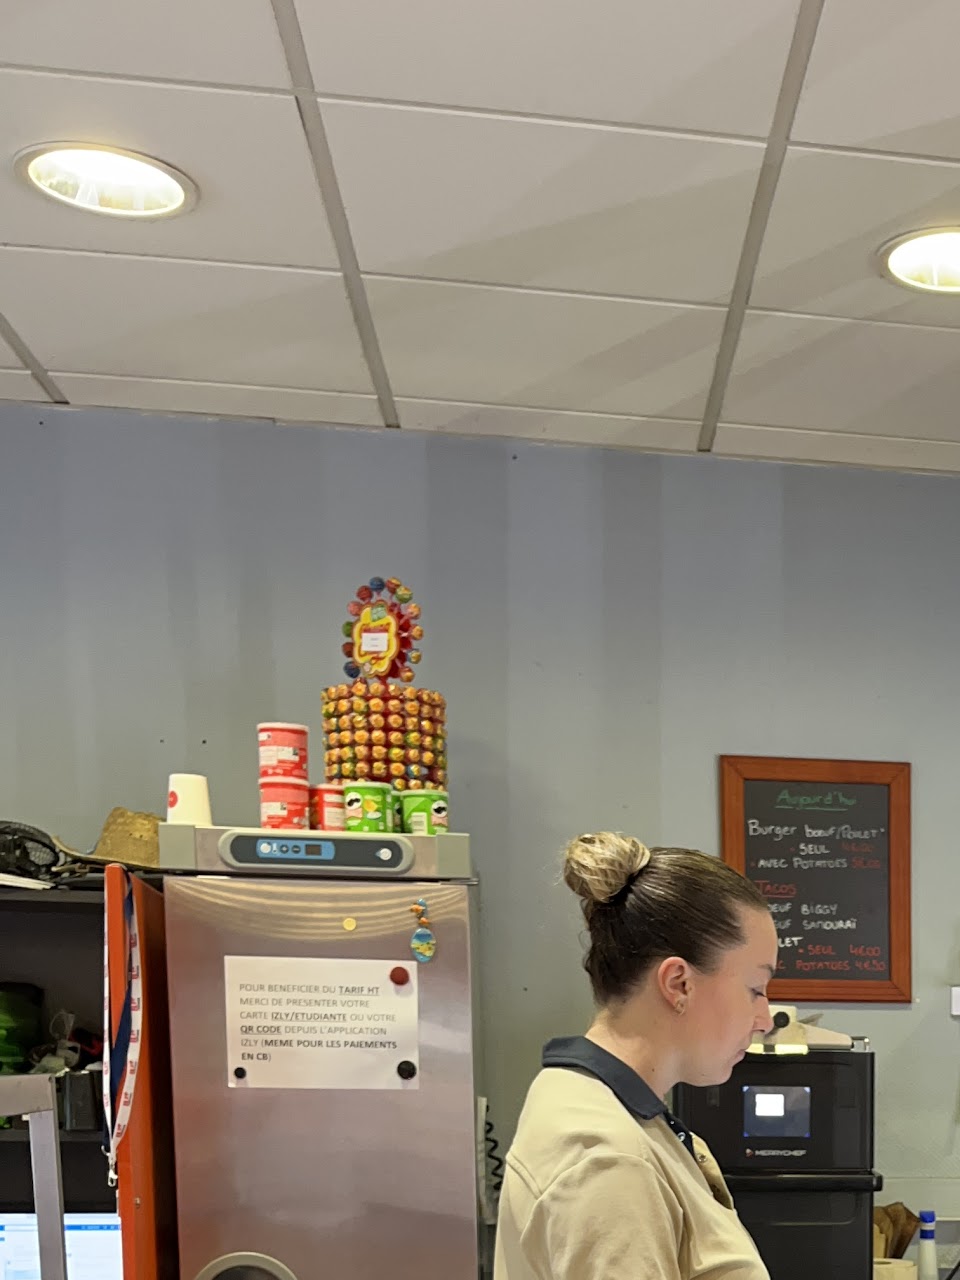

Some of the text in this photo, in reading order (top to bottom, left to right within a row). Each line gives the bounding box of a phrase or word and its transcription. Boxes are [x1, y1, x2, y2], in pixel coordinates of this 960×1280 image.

[747, 819, 797, 841] Burger
[799, 843, 830, 855] SEUL
[757, 858, 788, 868] AVEC
[754, 880, 797, 895] TACOS
[808, 944, 836, 955] SEUL
[796, 960, 850, 971] POTATOES
[239, 983, 380, 995] POUR BENEFICIER DU TARIF HT
[239, 998, 370, 1009] MERCI DE PRESENTER VOTRE
[239, 1011, 396, 1022] CARTE IZLY/ETUDIANTE OU VOTRE
[240, 1025, 387, 1035] QR CODE DEPUIS L'APPLICATION
[240, 1038, 397, 1049] IZLY (MEME POUR LES PAIEMENTS
[241, 1052, 271, 1062] EN CB)
